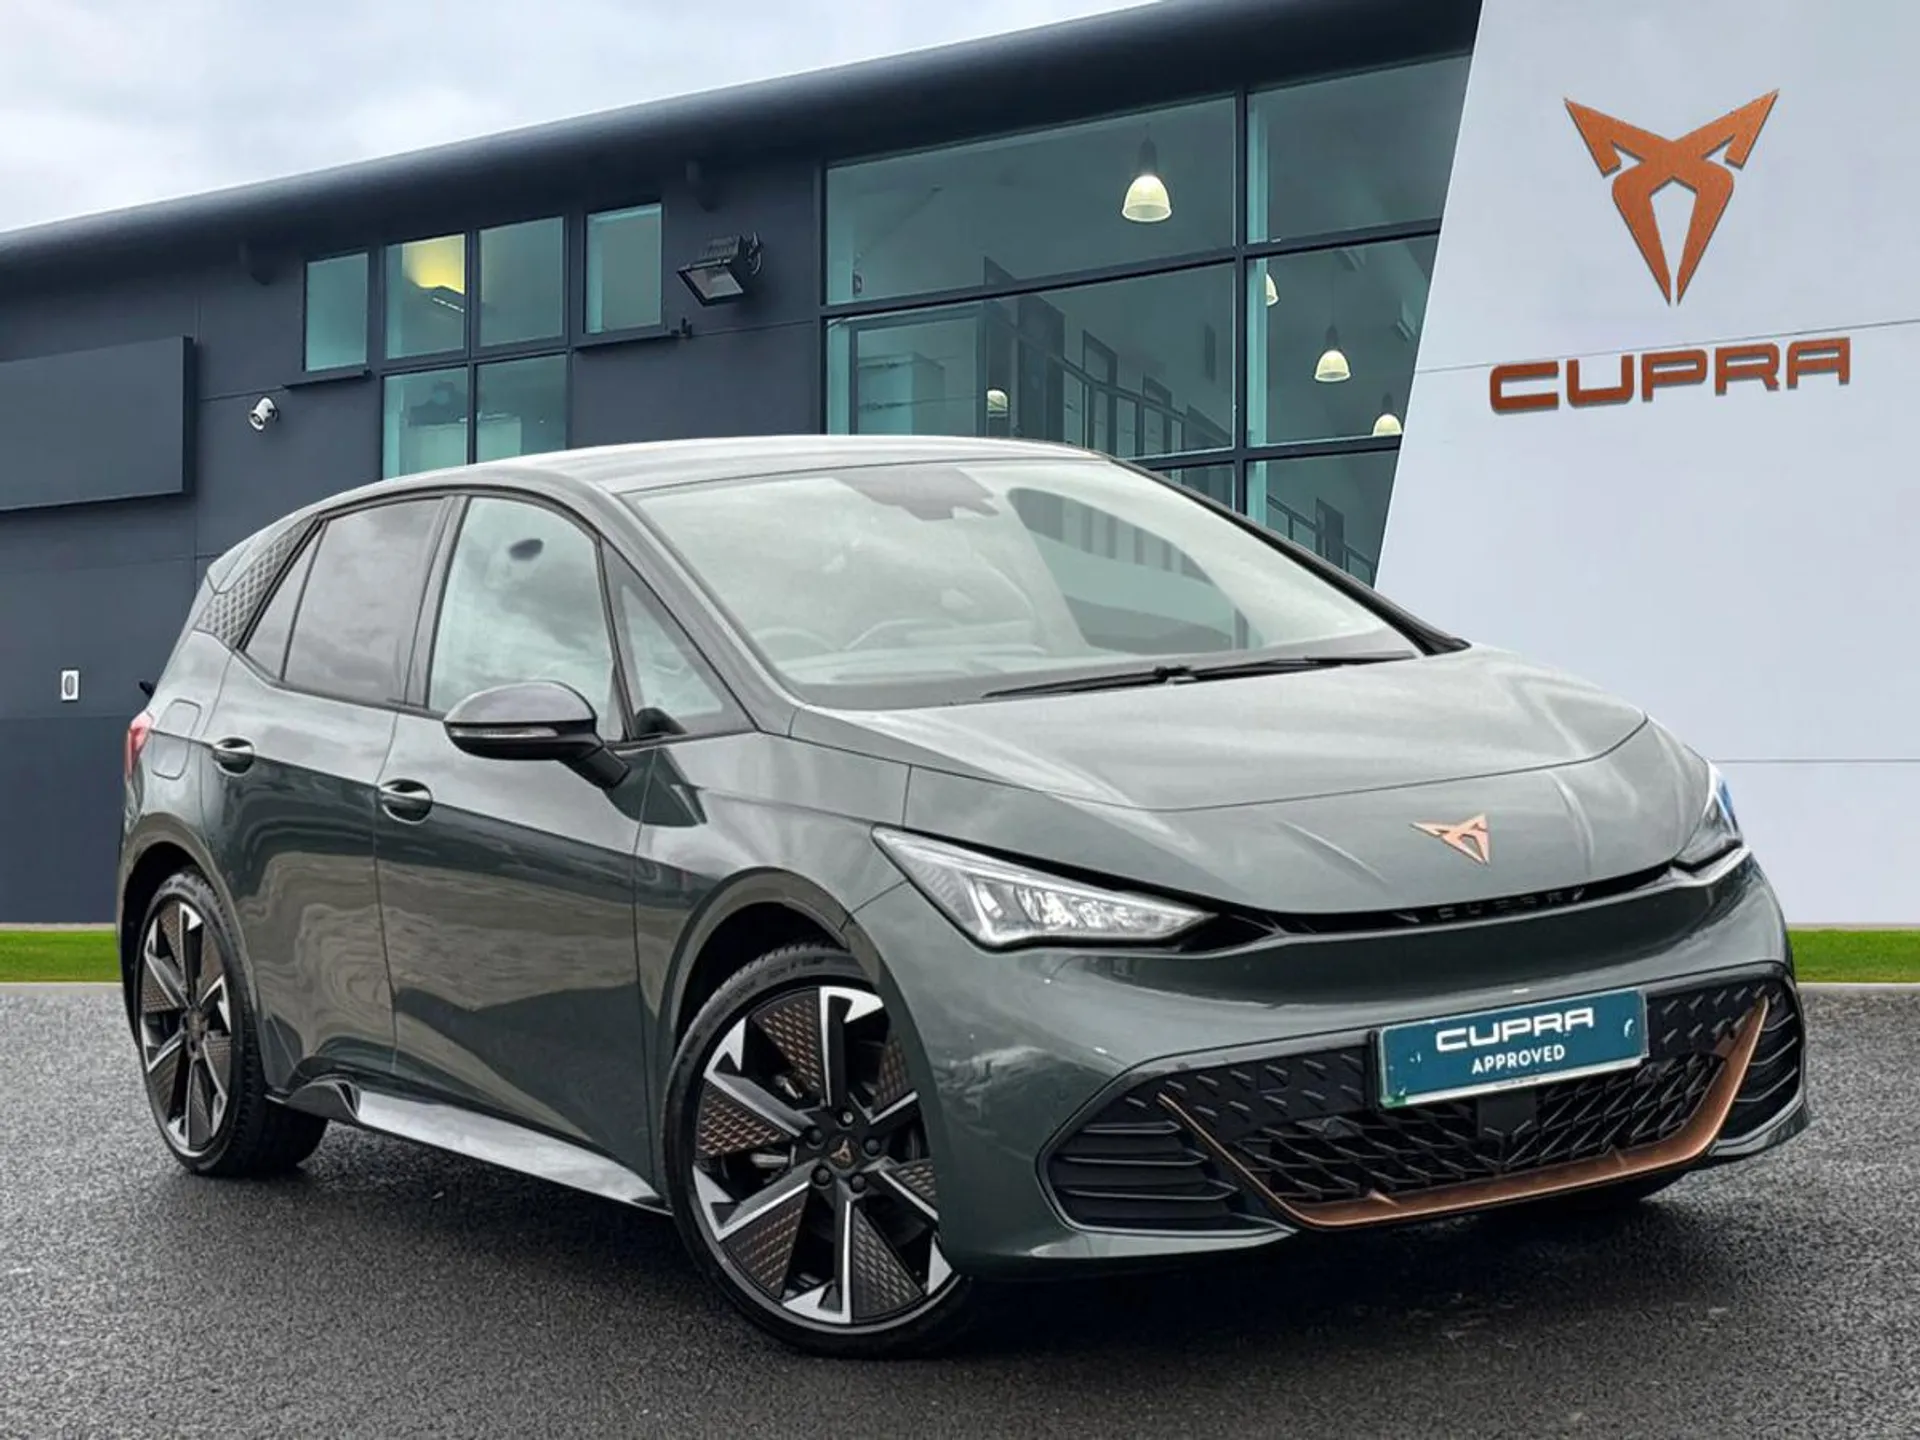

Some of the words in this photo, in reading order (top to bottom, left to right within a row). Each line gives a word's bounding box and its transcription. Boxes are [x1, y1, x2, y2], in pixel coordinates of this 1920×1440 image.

[1489, 337, 1850, 414] CUPRA
[1435, 1006, 1595, 1052] CUPRA
[1471, 1044, 1566, 1075] APPROVED
